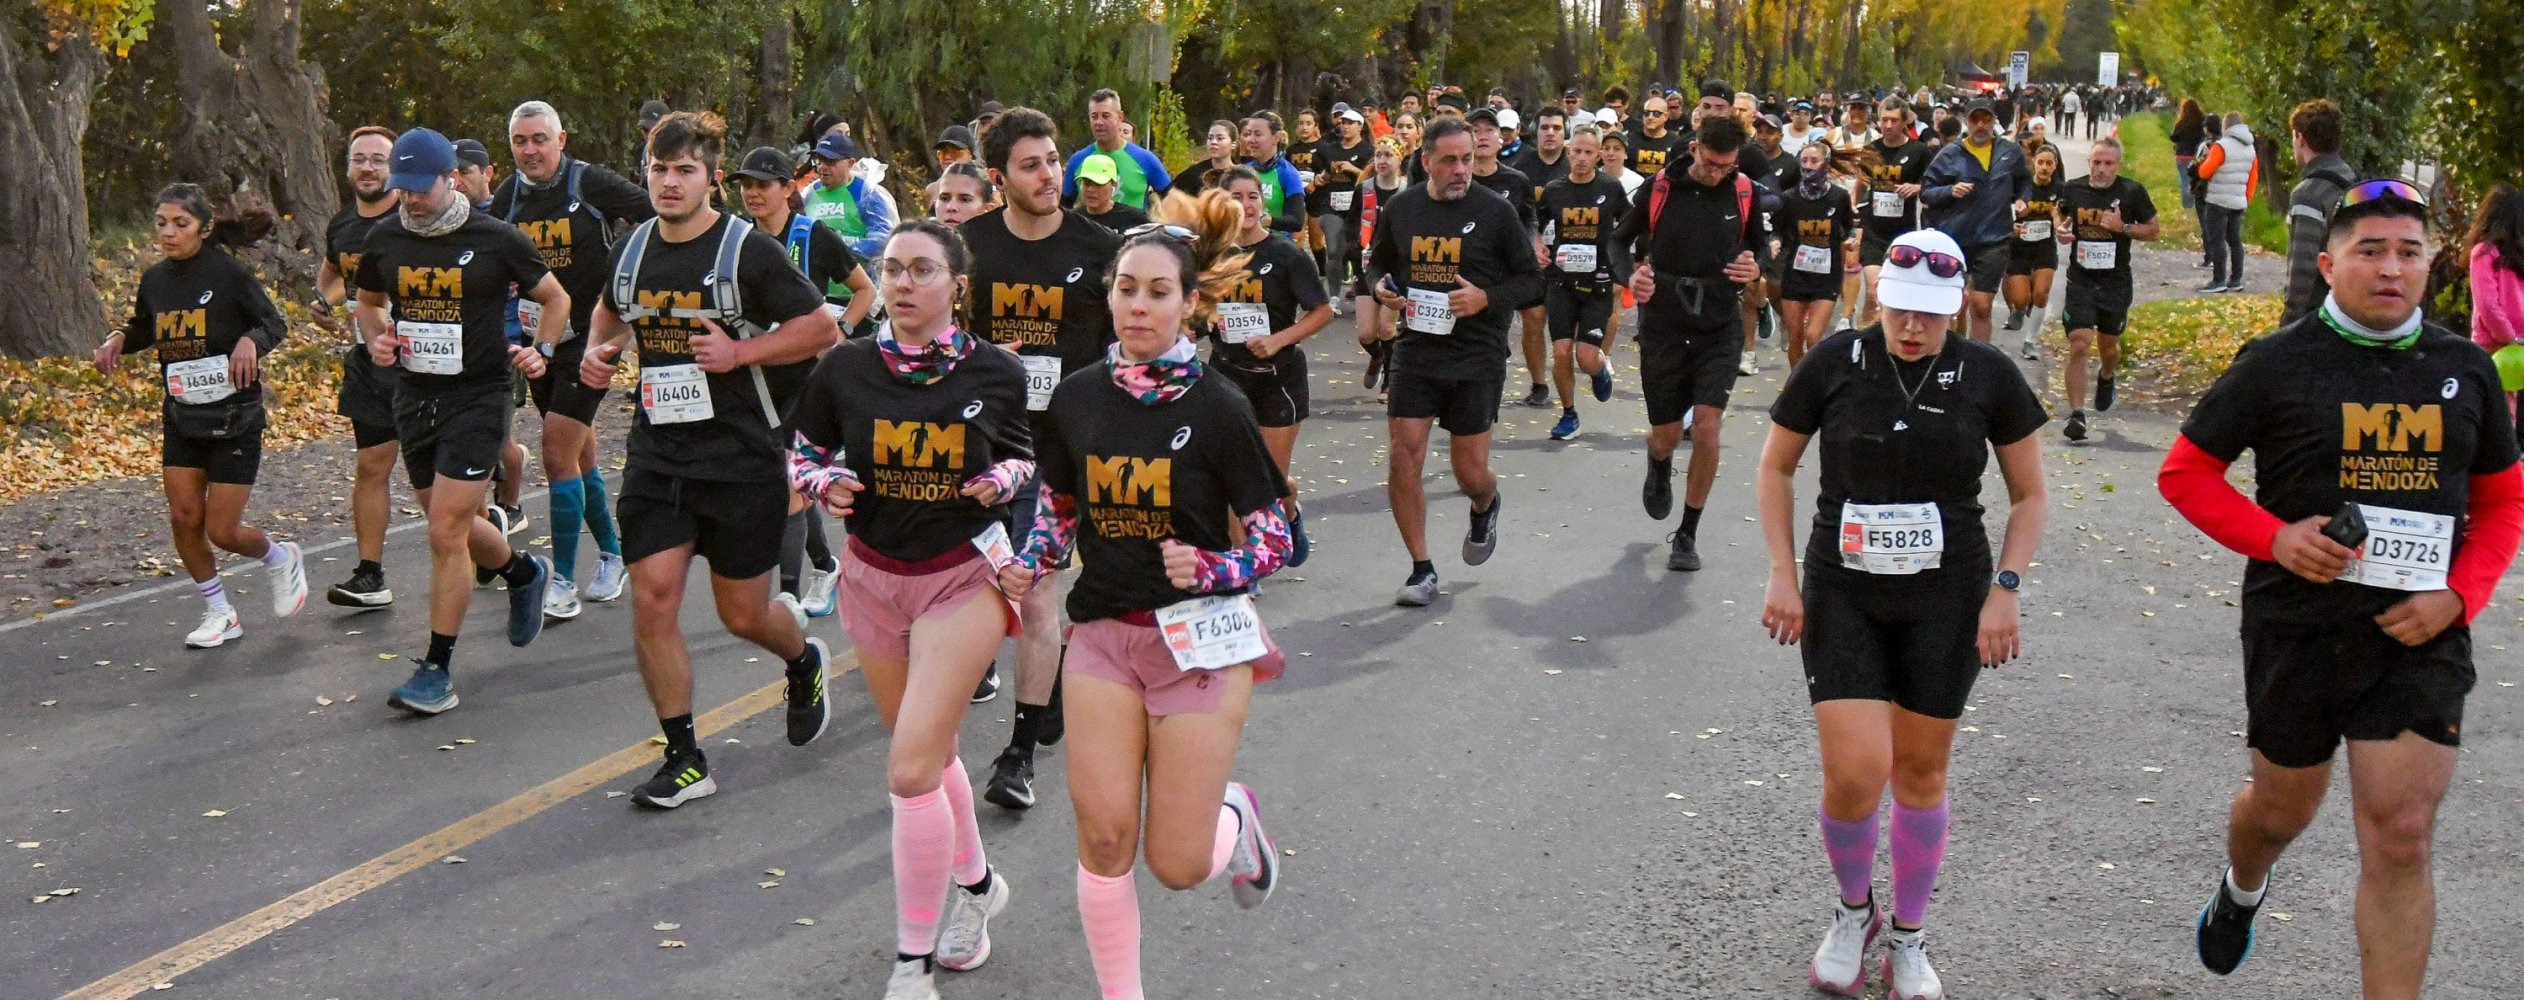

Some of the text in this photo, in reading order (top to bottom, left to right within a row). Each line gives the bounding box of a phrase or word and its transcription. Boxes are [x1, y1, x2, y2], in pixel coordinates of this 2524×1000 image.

[1638, 149, 1667, 164] MM
[1562, 206, 1600, 225] MM
[1797, 219, 1832, 237] MM
[560, 247, 571, 256] DE
[1411, 235, 1462, 263] MM
[1411, 272, 1458, 284] MENDOZA
[1448, 265, 1459, 273] DE
[398, 265, 463, 298] MM
[401, 298, 461, 309] MARATÓN DE
[992, 282, 1064, 321] MM
[402, 308, 462, 322] MENDOZA
[1227, 314, 1264, 328] D3596
[1417, 304, 1452, 320] C3228
[156, 308, 206, 340] MM
[992, 319, 1058, 333] MARATÓN DE
[992, 329, 1057, 346] MENDOZA
[413, 340, 455, 355] D4261
[187, 371, 225, 389] J6368
[657, 384, 701, 402] J6406
[2342, 402, 2443, 452] MM
[873, 418, 966, 470] MM
[2341, 453, 2439, 471] MARATÓN DE
[874, 468, 961, 485] MARATÓN DE
[1086, 454, 1171, 507] MM
[2340, 471, 2440, 491] MENDOZA
[875, 481, 961, 501] MENDOZA
[1868, 529, 1933, 549] F5828
[2371, 537, 2440, 564] D3726
